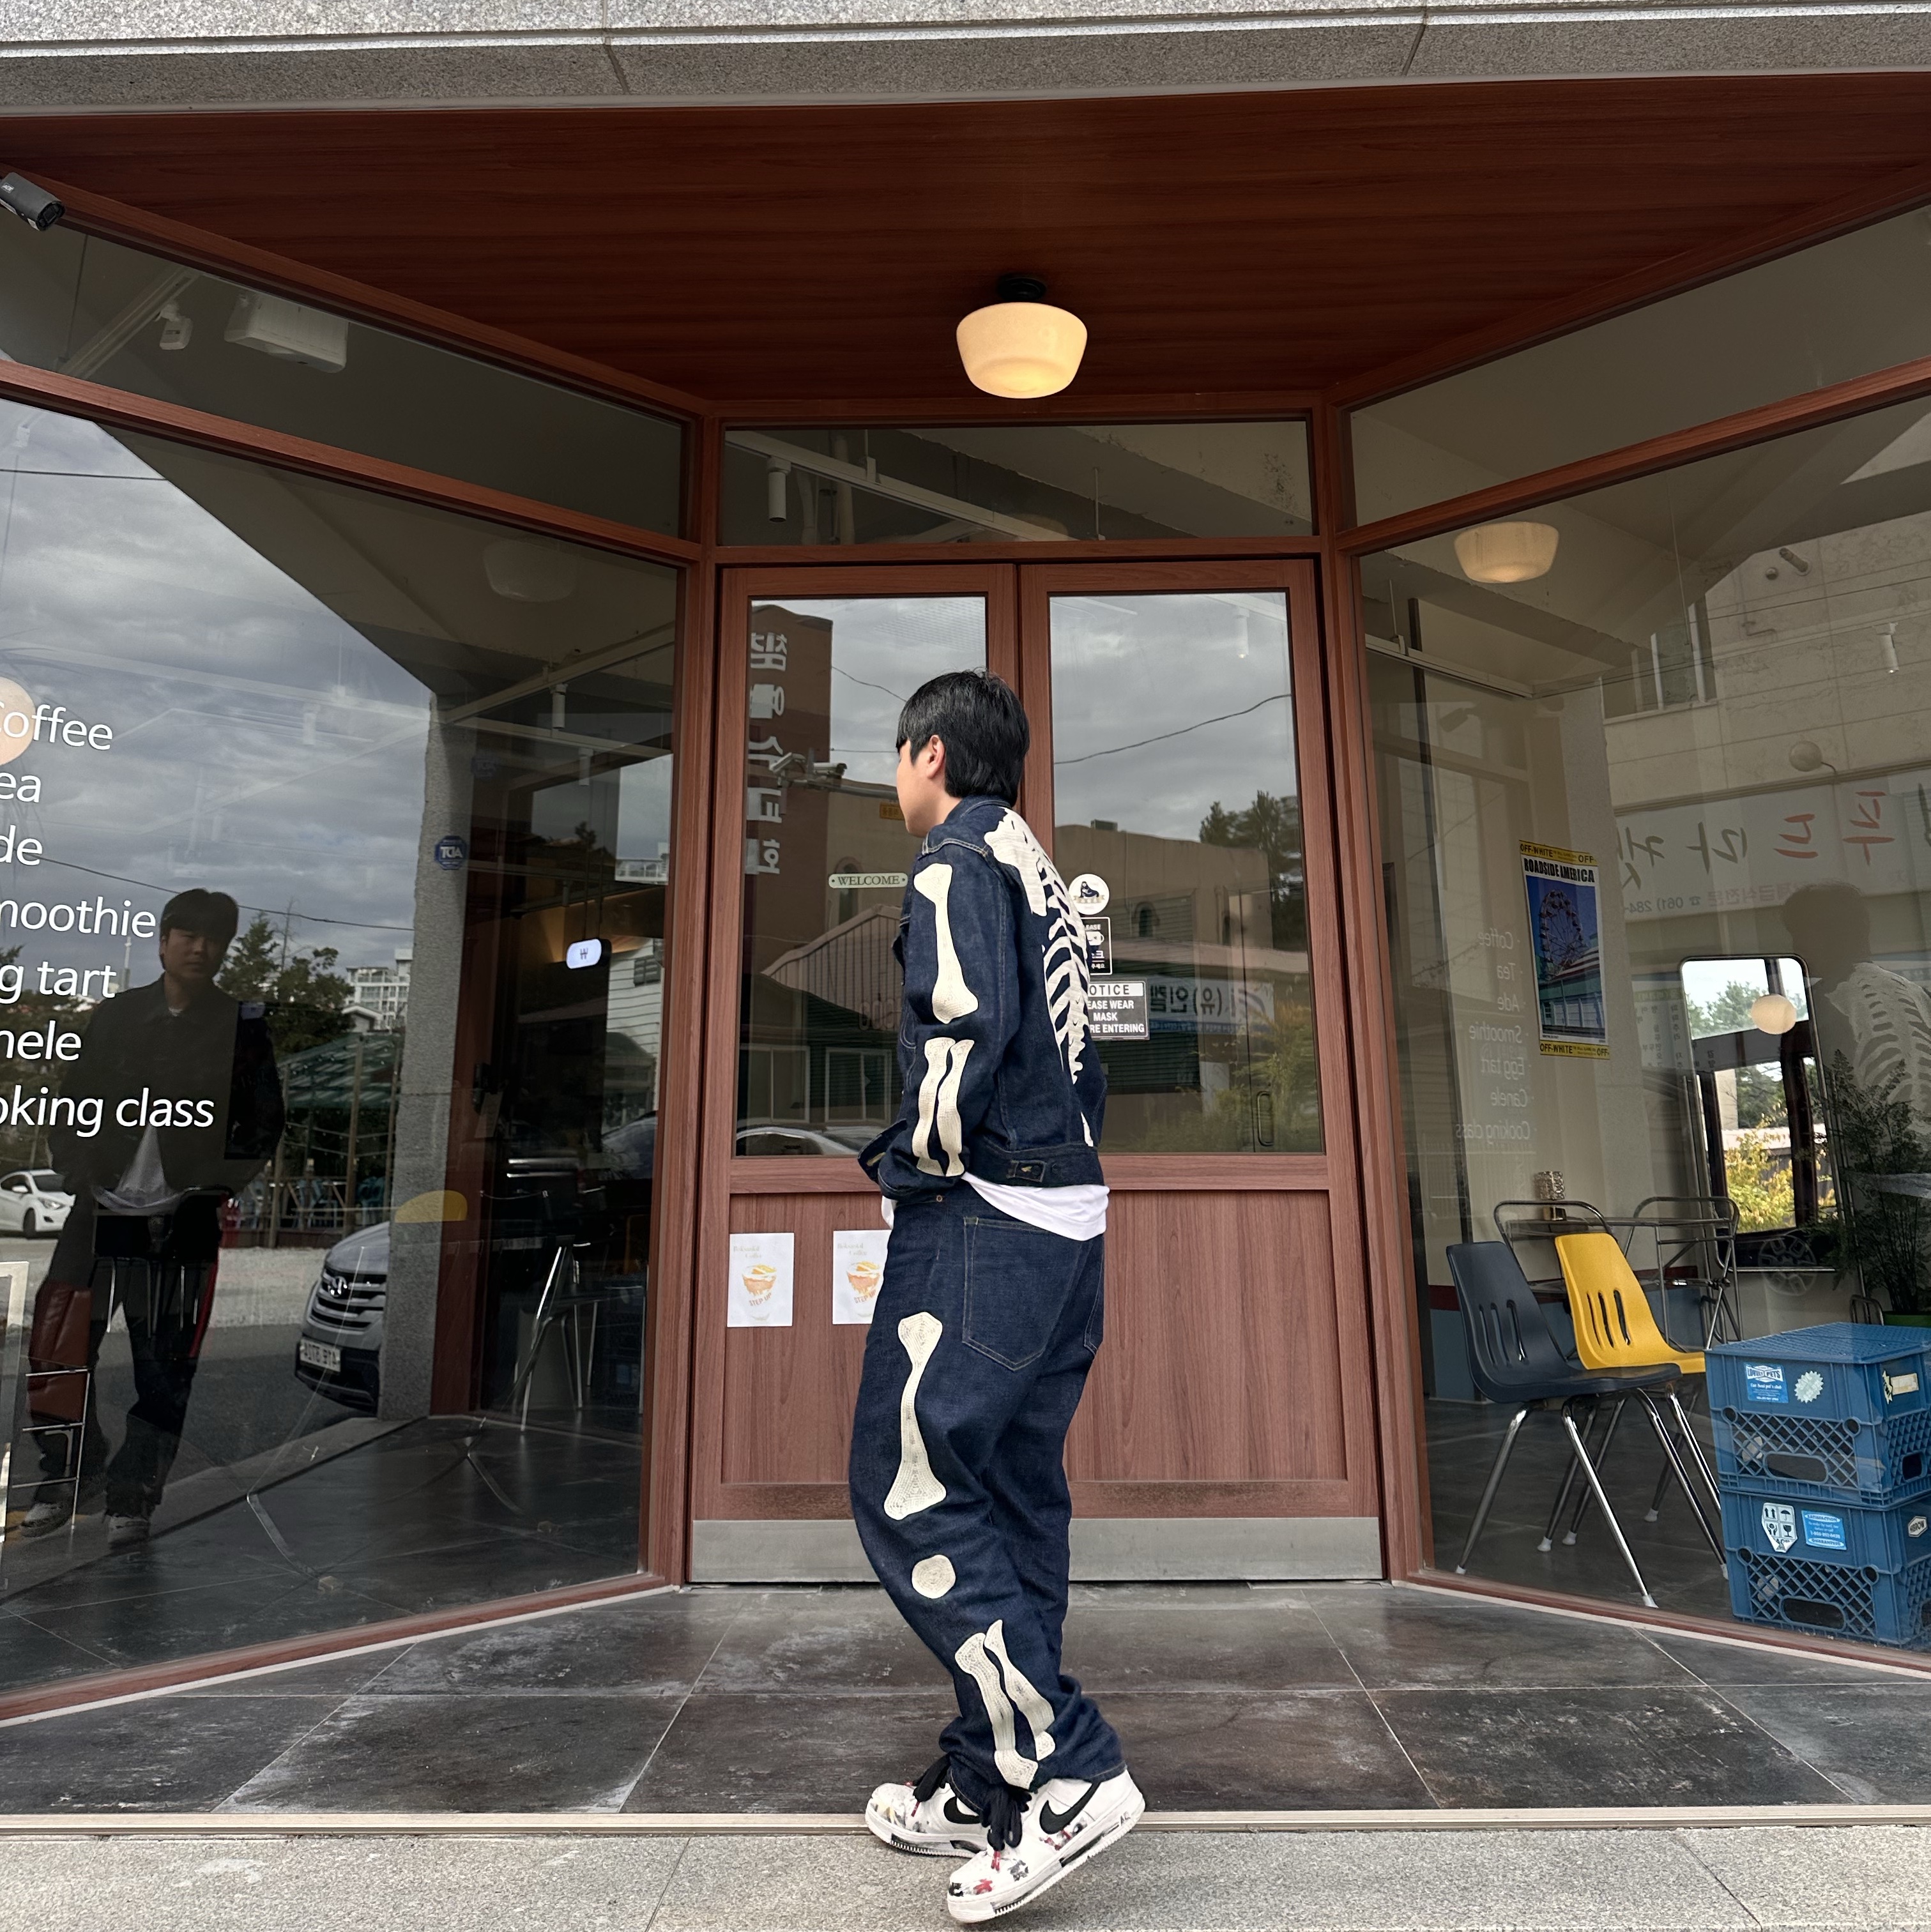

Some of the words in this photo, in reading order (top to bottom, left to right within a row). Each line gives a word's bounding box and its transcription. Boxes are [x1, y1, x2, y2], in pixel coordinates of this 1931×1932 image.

[0, 700, 113, 750] offee
[0, 772, 42, 803] ea
[0, 825, 43, 866] de
[1520, 843, 1553, 857] OFF-WHITE
[1523, 858, 1560, 878] ROADSIDE
[1559, 865, 1595, 883] AMERICA
[837, 875, 901, 886] WELCOME
[0, 896, 156, 938] oothie
[1091, 950, 1105, 959] 크
[36, 961, 117, 998] tart
[1089, 984, 1130, 996] OTICE
[1088, 1000, 1108, 1010] EASE
[1109, 1000, 1134, 1009] WEAR
[1093, 1012, 1118, 1021] MASK
[1102, 1023, 1145, 1033] ENTERING
[0, 1020, 82, 1061] nele
[1539, 1043, 1573, 1054] OFF-WHITE
[0, 1084, 104, 1137] king
[116, 1087, 215, 1127] class
[748, 1297, 764, 1307] STEP
[764, 1293, 772, 1302] UP
[853, 1295, 869, 1304] STEP
[869, 1289, 877, 1298] UP
[1766, 1370, 1781, 1379] PETS
